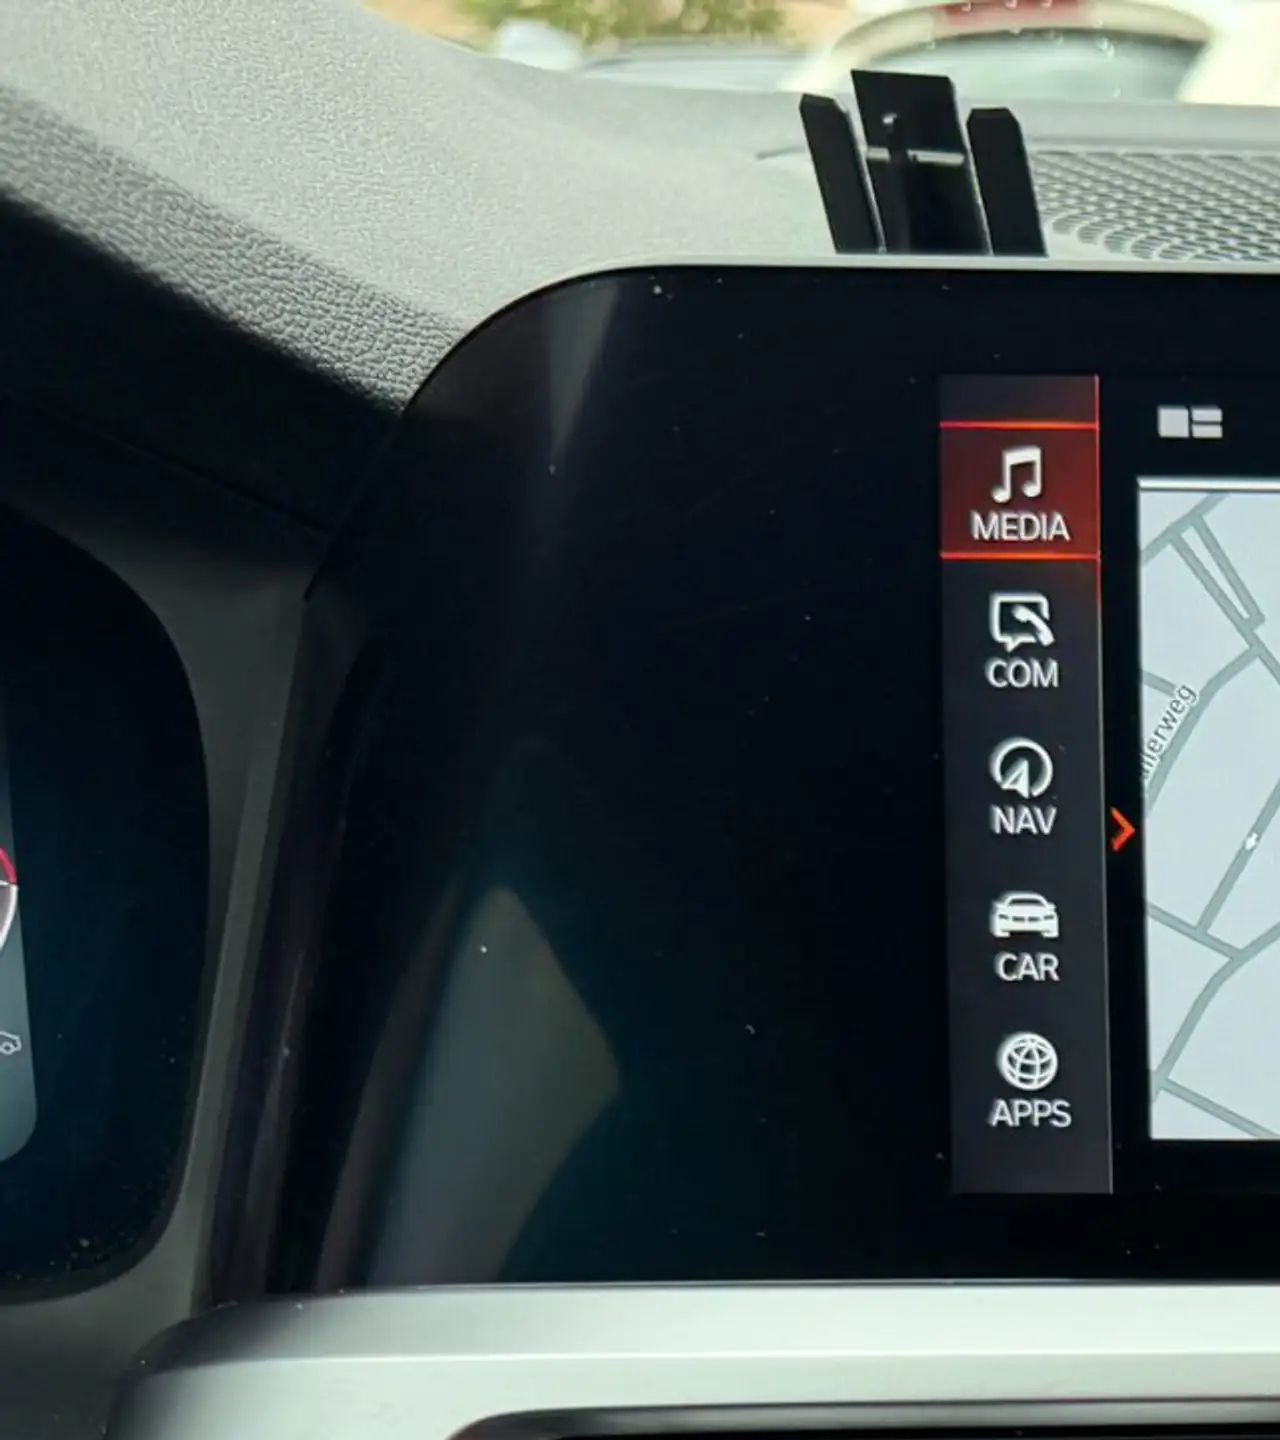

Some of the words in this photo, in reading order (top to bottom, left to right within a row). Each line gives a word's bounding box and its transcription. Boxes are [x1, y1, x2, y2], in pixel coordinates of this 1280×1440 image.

[973, 511, 1071, 542] MEDIA
[987, 659, 1058, 688] COM
[992, 806, 1057, 834] NAV
[996, 953, 1059, 981] CAR
[990, 1099, 1072, 1128] APPS
